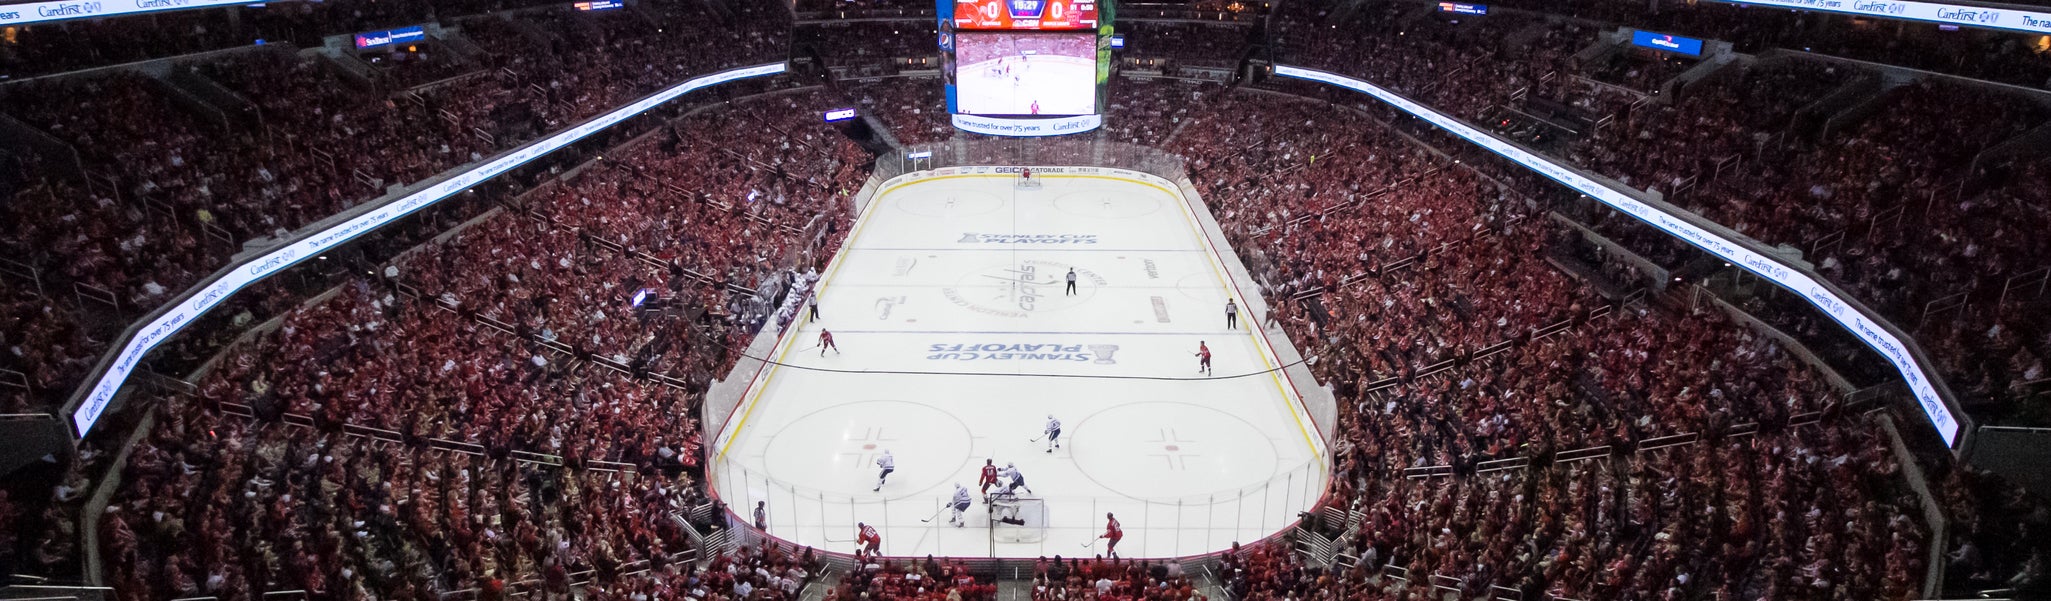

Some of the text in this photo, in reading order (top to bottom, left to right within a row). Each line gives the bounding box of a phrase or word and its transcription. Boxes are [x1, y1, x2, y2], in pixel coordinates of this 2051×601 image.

[38, 4, 82, 17] CareFirst
[987, 2, 998, 18] 0
[1051, 2, 1063, 18] 0
[1854, 0, 1887, 12] CareFirst
[0, 11, 20, 20] ears
[1937, 7, 1978, 21] CareFirst
[2022, 16, 2051, 28] The na
[1024, 125, 1040, 133] years
[250, 256, 280, 275] CareFirst
[1744, 254, 1772, 273] CareFirst
[150, 328, 162, 340] over
[170, 312, 185, 328] years
[1855, 318, 1864, 330] The
[1863, 326, 1877, 341] name
[1877, 336, 1897, 355] trusted
[929, 342, 1083, 352] PLAYOFFS
[926, 352, 1091, 362] STANLEY CUP
